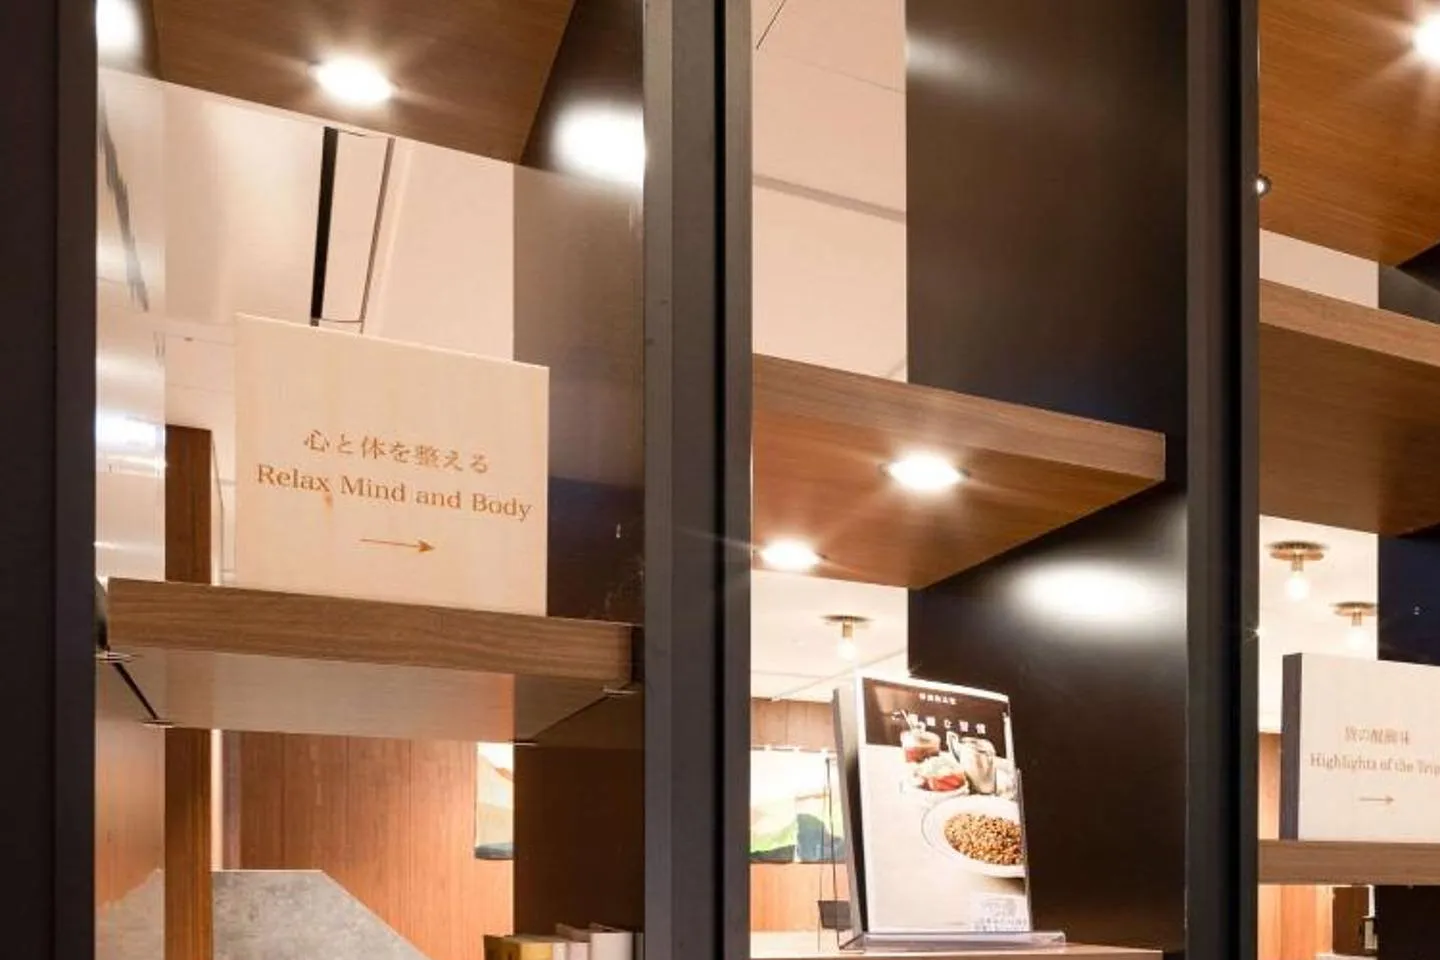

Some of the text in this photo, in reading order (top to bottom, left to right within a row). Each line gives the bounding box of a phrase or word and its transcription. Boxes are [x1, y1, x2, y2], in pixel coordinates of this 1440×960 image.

[303, 429, 490, 474] 心と体を整える
[256, 462, 533, 522] Relax Mind and Body
[1309, 752, 1378, 775] Highlights
[1380, 757, 1394, 771] of
[1395, 760, 1414, 773] the
